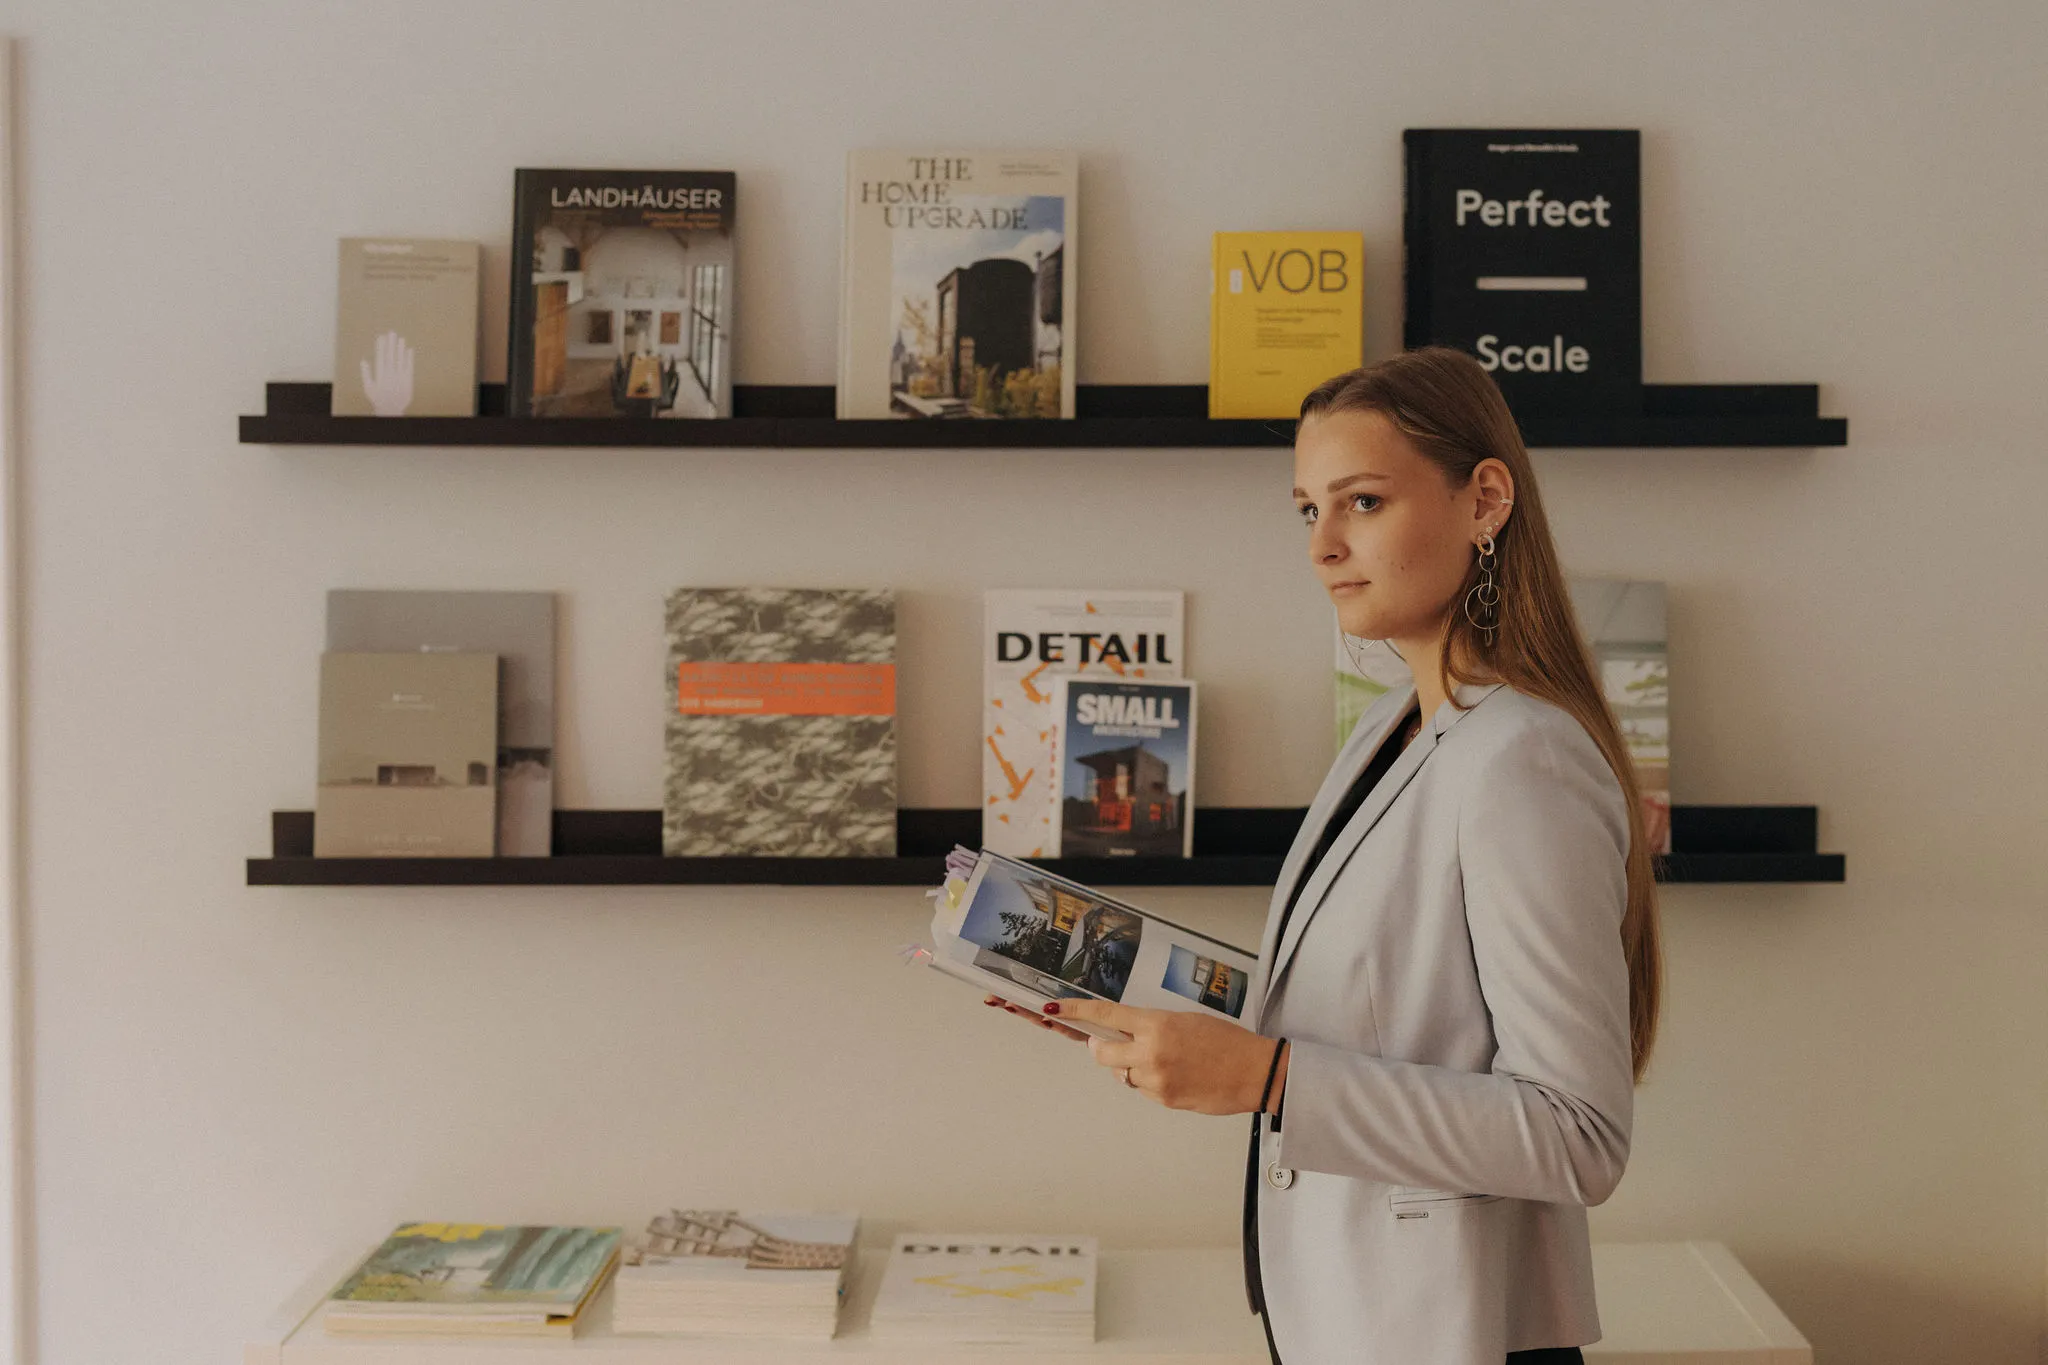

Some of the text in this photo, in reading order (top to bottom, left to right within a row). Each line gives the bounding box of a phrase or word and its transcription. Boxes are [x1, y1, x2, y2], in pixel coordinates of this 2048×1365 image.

[909, 157, 973, 181] THE
[551, 185, 723, 210] LANDHÄUSER
[860, 181, 952, 205] HOME
[883, 206, 1029, 230] UPGRADE
[1455, 188, 1612, 228] Perfect
[1242, 248, 1349, 293] VOB
[1476, 334, 1590, 373] Scale
[997, 632, 1172, 664] DETAIL
[1076, 693, 1180, 728] SMALL
[902, 1244, 1083, 1256] DETAIL
